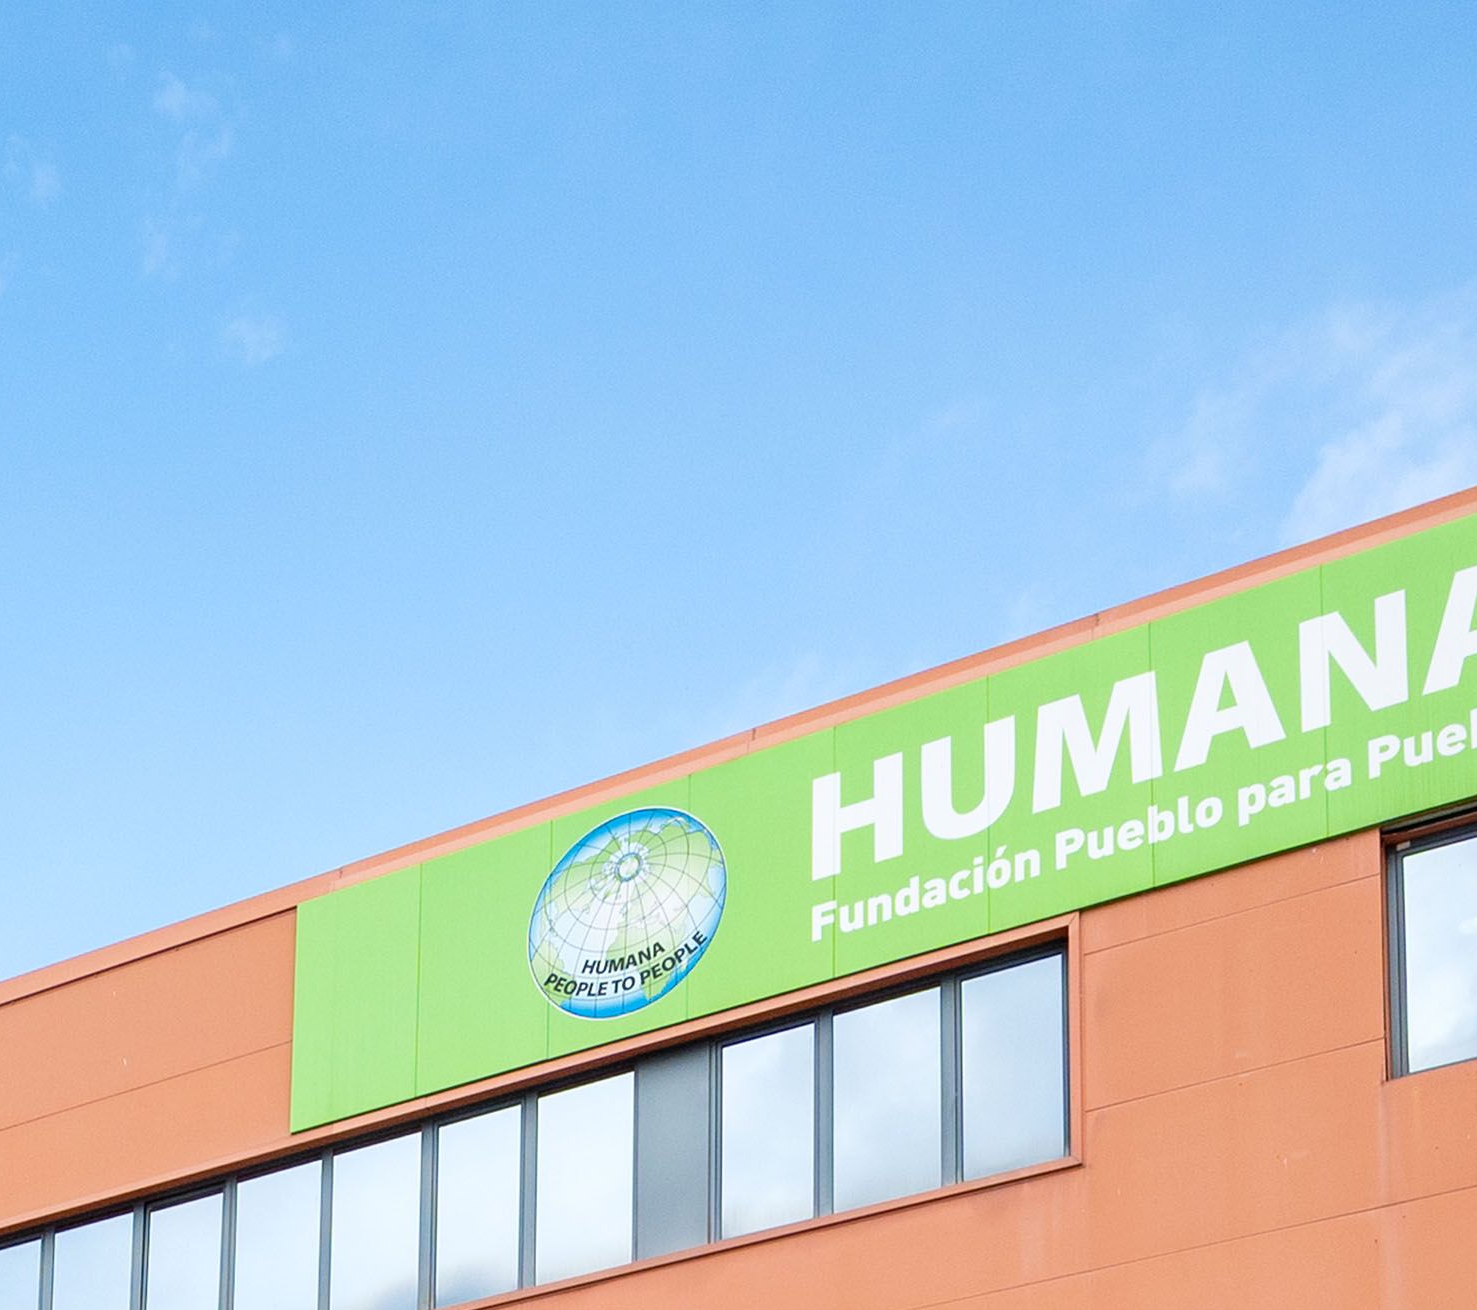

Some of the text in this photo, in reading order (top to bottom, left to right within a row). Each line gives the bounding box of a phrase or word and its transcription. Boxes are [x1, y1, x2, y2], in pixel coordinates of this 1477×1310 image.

[810, 843, 1042, 943] Fundación
[1054, 791, 1225, 871] Pueblo
[1236, 756, 1352, 828] para
[544, 931, 708, 996] PEOPLE TO PEOPLE
[581, 941, 666, 974] HUMANA
